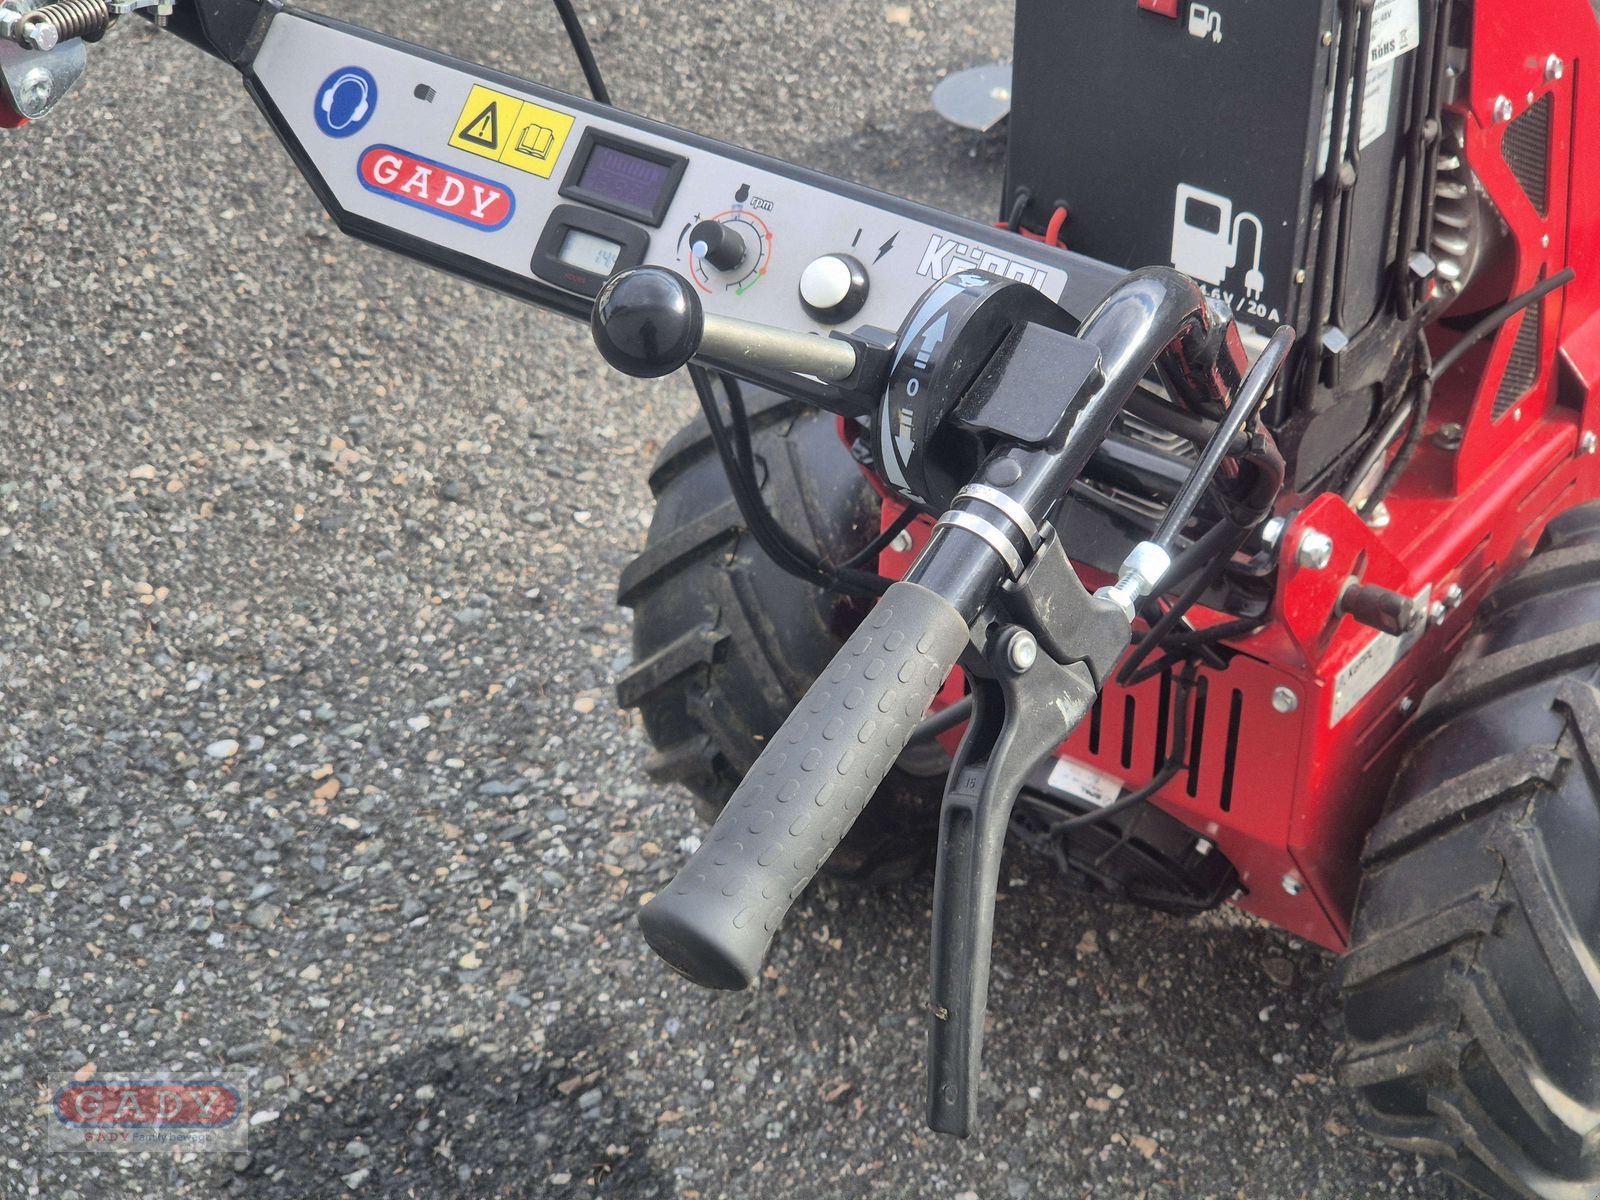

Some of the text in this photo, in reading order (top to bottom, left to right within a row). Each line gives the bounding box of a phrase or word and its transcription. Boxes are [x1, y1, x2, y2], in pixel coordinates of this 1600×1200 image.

[373, 155, 501, 218] GADY
[750, 196, 774, 212] rpm
[1199, 285, 1221, 299] 4.6
[1222, 292, 1234, 307] V
[1247, 301, 1267, 318] 20
[1268, 308, 1280, 322] A
